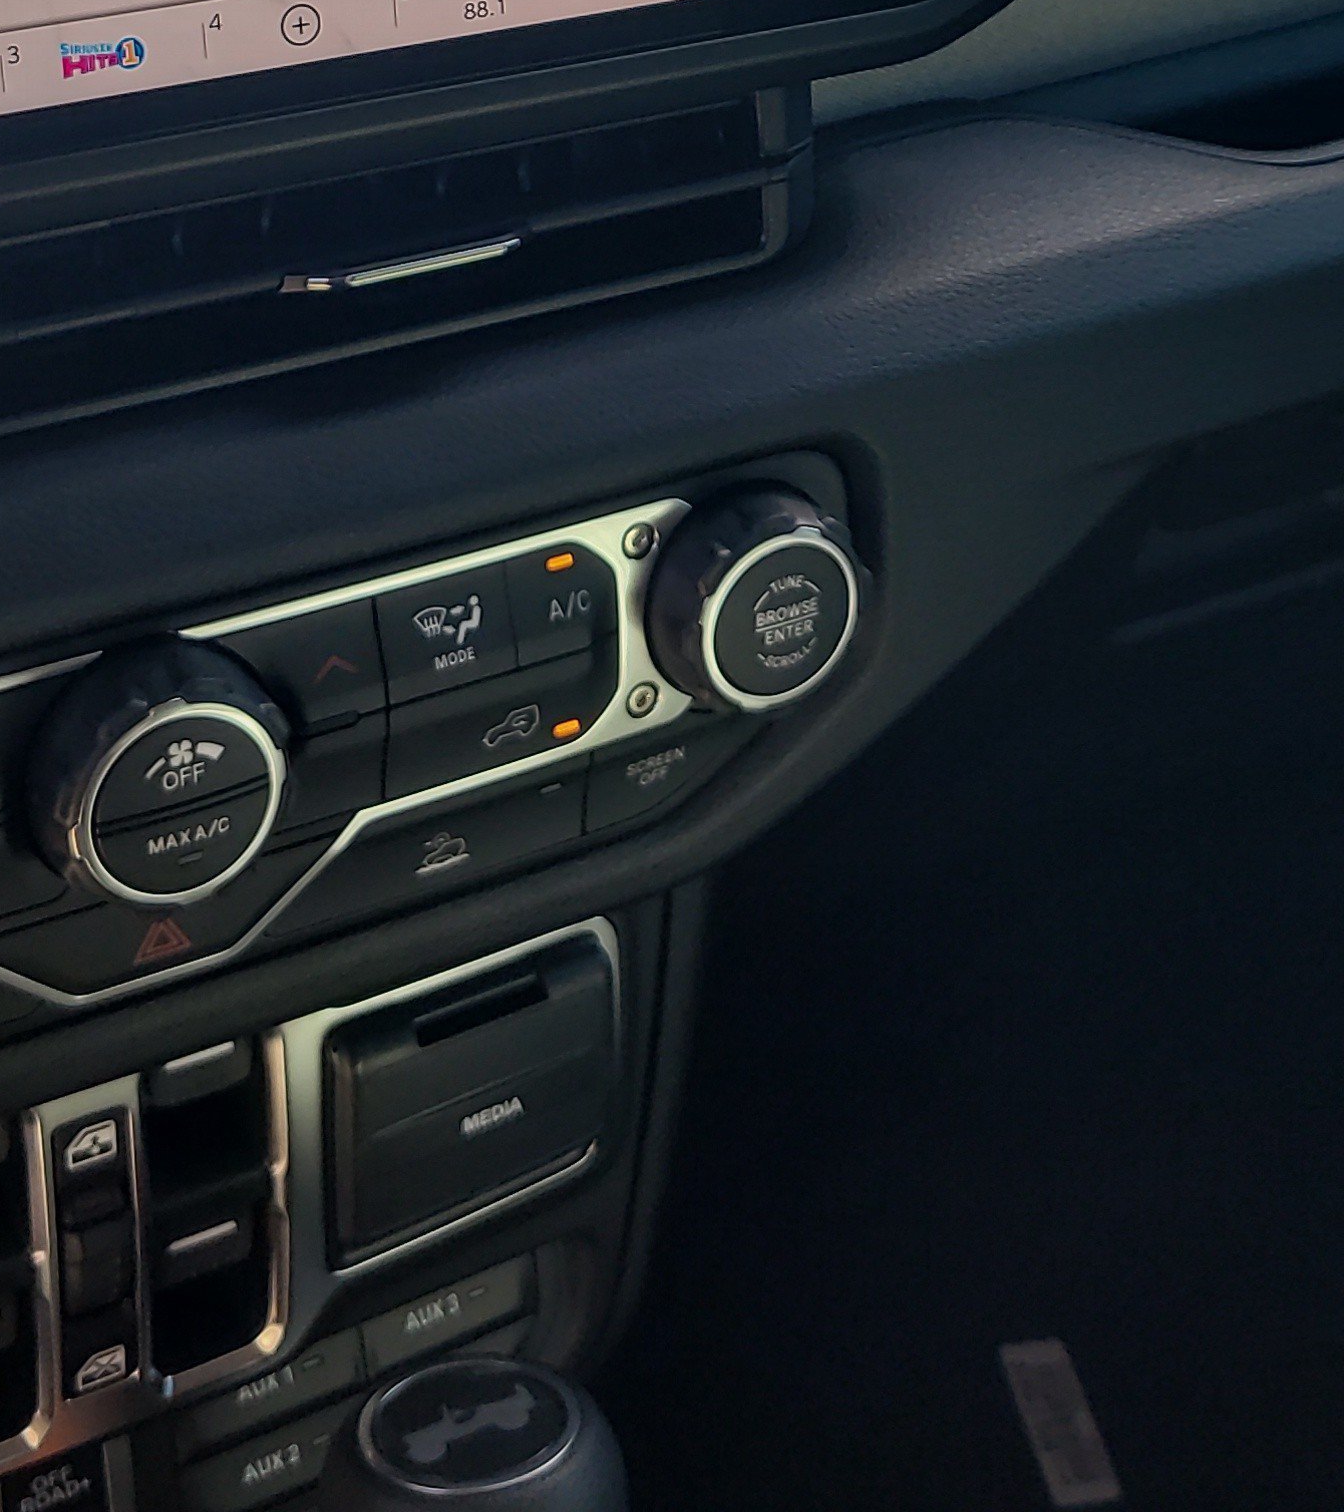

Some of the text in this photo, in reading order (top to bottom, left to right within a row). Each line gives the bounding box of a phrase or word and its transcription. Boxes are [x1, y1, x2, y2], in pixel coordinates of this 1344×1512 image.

[208, 13, 223, 32] 4
[6, 45, 20, 65] 3
[549, 589, 591, 621] A/C
[756, 596, 818, 627] BROWSE
[765, 619, 813, 645] ENTER
[434, 646, 476, 670] MODE
[163, 761, 205, 789] OFF
[627, 746, 684, 776] SCREEN
[147, 817, 230, 855] MAX A/C
[459, 1096, 524, 1136] MEDIA
[406, 1299, 444, 1331] AUX
[239, 1372, 279, 1404] AUX
[241, 1449, 285, 1486] AUX
